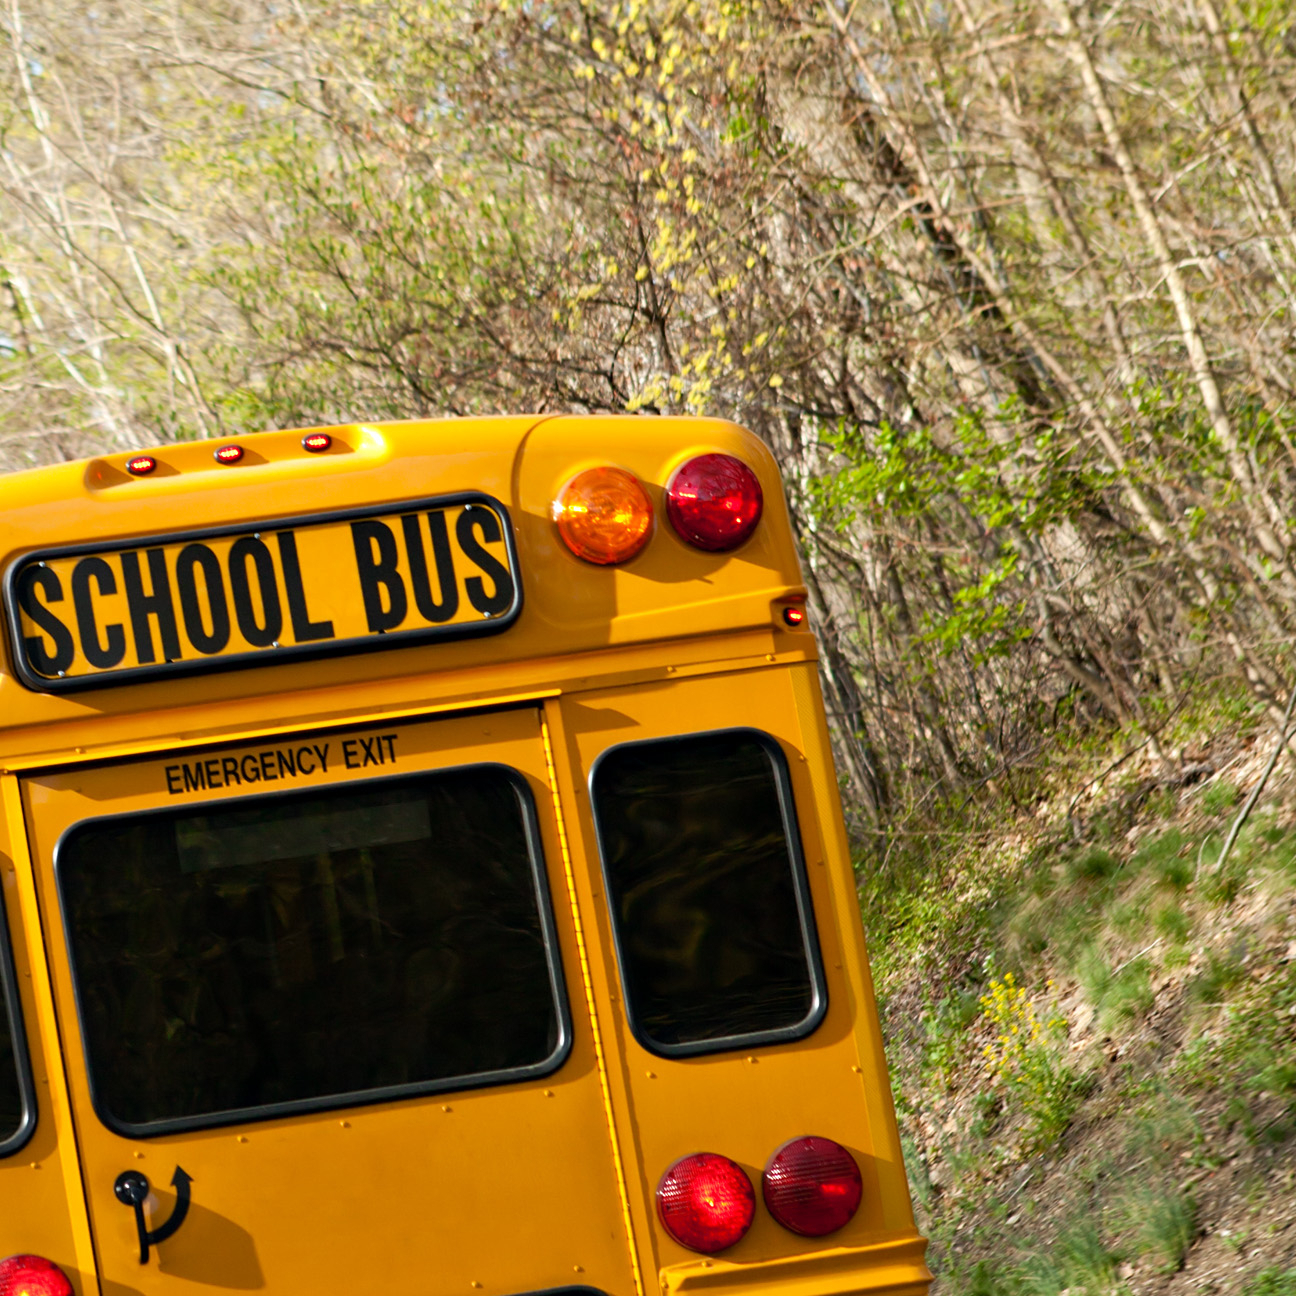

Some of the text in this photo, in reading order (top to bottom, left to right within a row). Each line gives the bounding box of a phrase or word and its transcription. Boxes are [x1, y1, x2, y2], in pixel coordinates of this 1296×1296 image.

[18, 505, 515, 676] SCHOOL BUS
[164, 734, 399, 795] EMERGENCY EXIT
